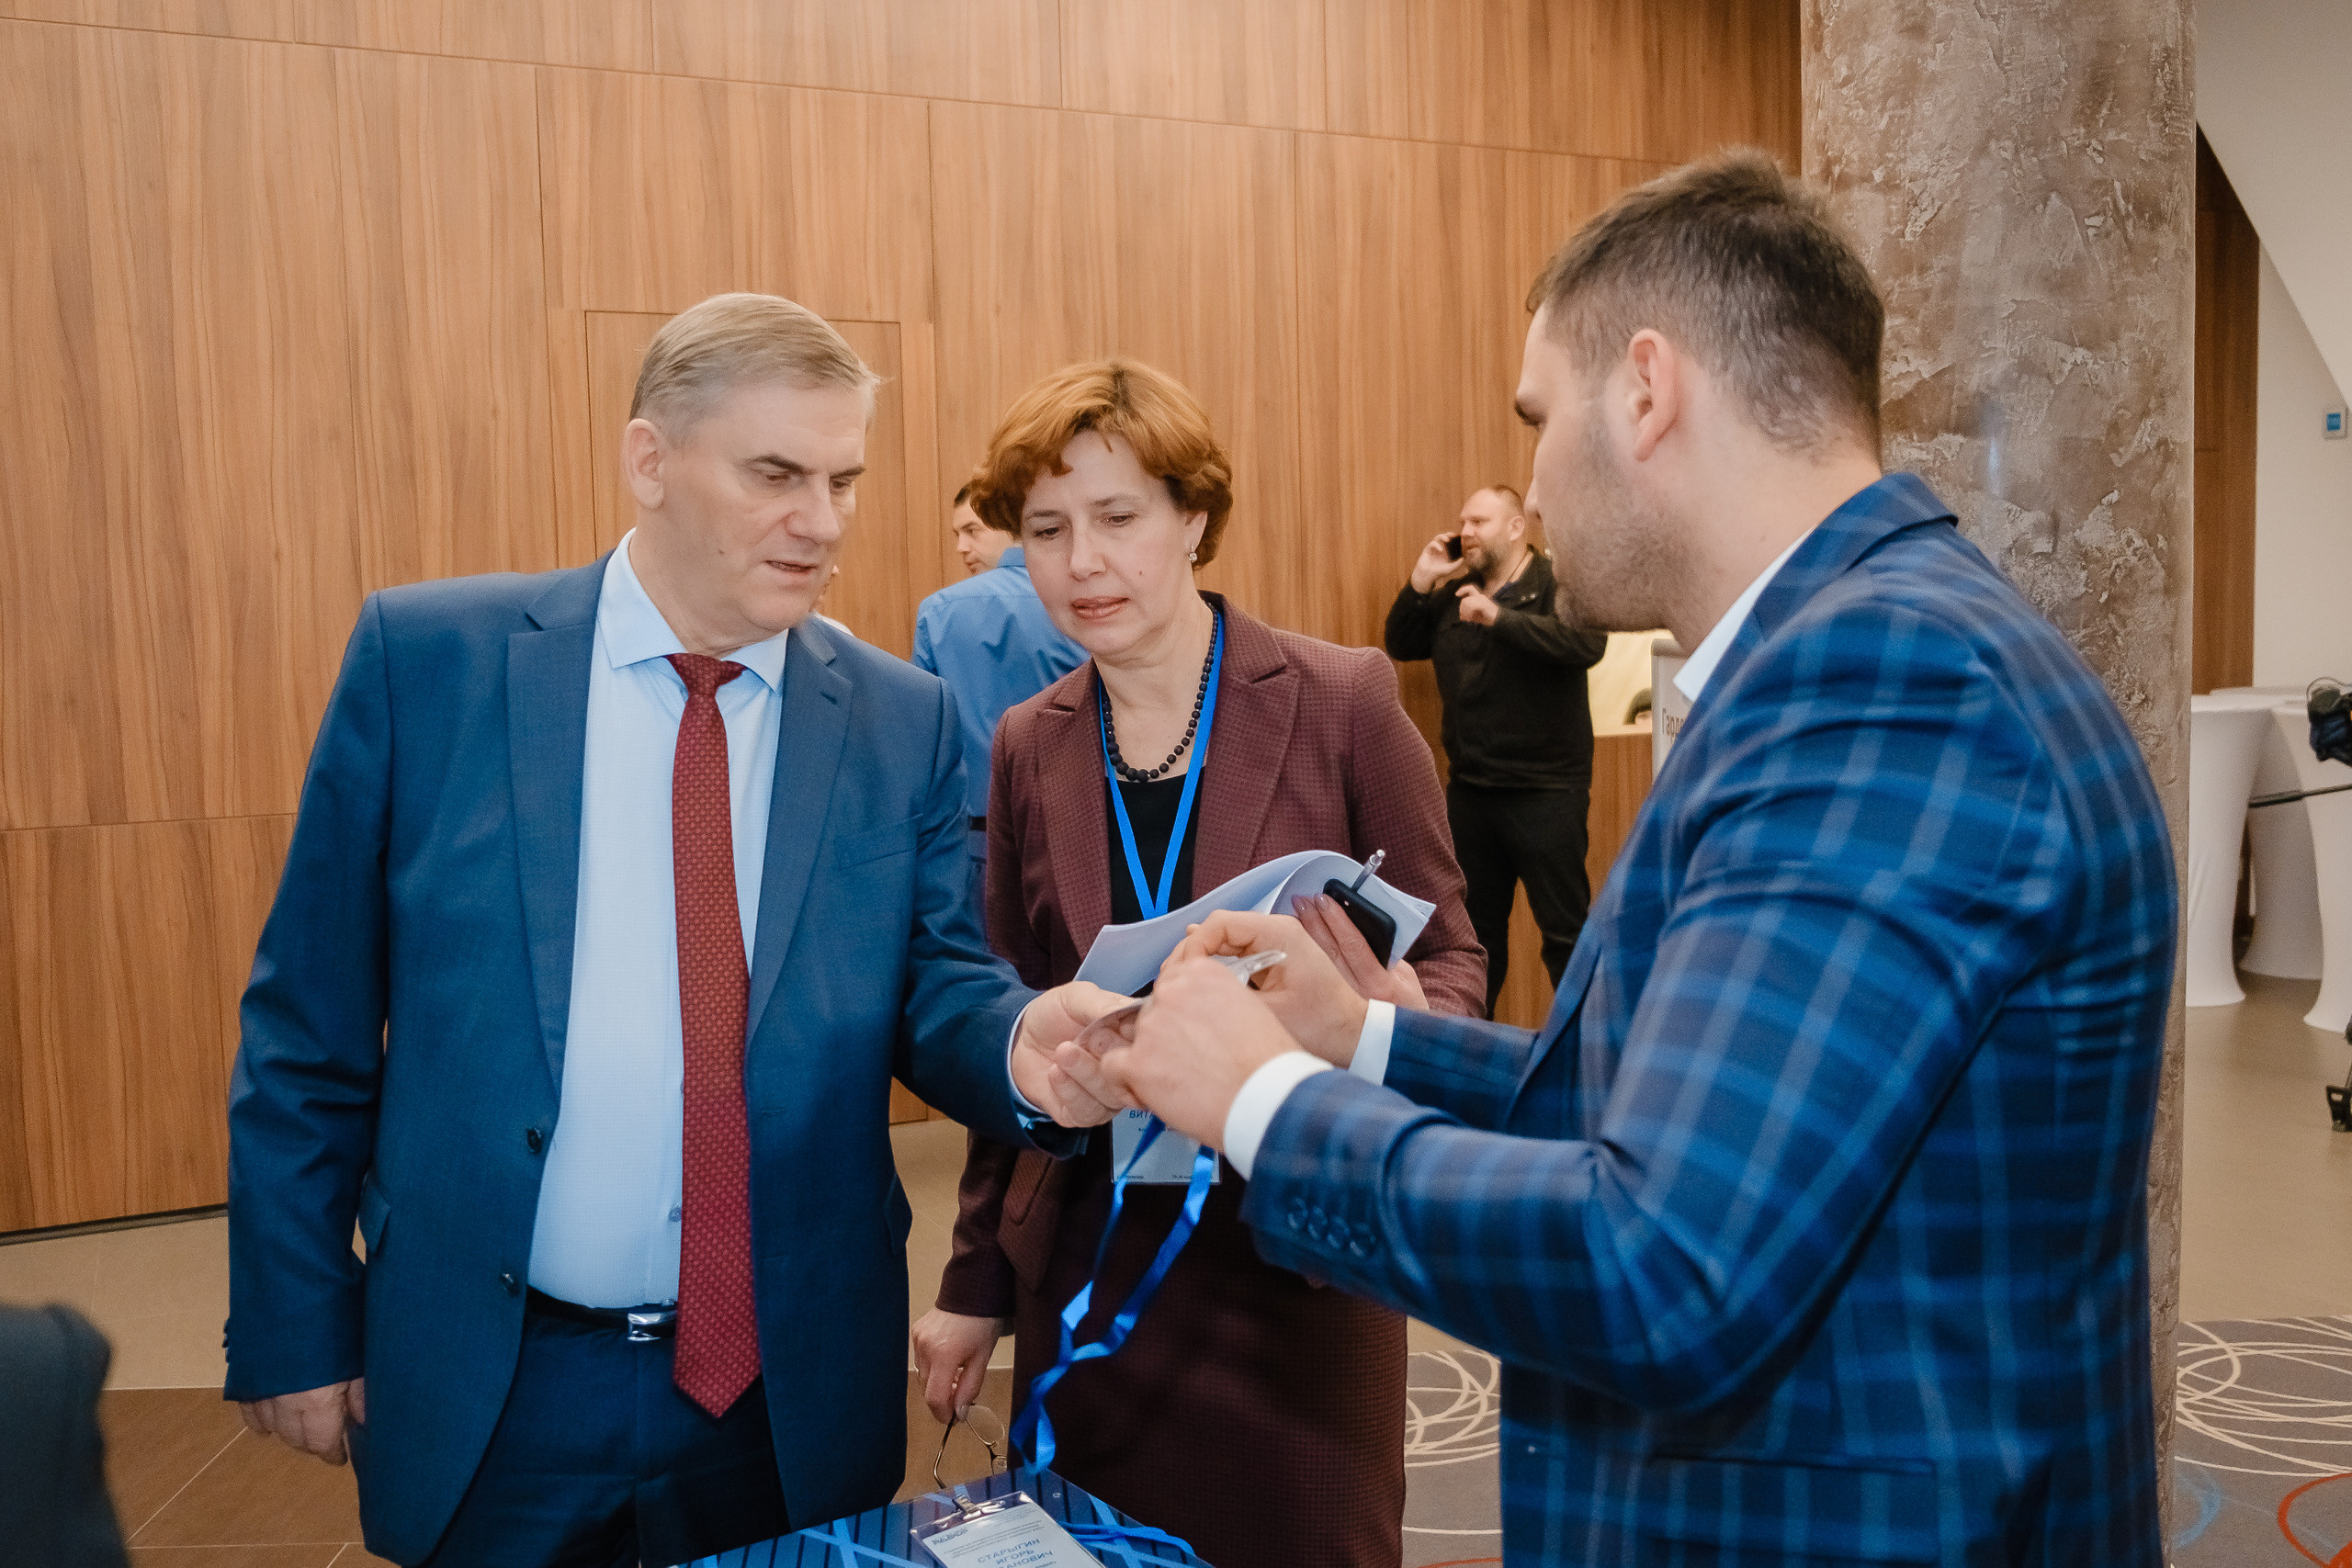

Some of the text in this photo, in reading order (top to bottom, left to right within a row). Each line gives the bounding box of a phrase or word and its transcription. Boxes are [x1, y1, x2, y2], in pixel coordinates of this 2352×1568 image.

[978, 1539, 1040, 1562] СТАРЫГИН
[996, 1550, 1035, 1564] ИГОРЬ
[999, 1550, 1053, 1568] АНОВИЧ
